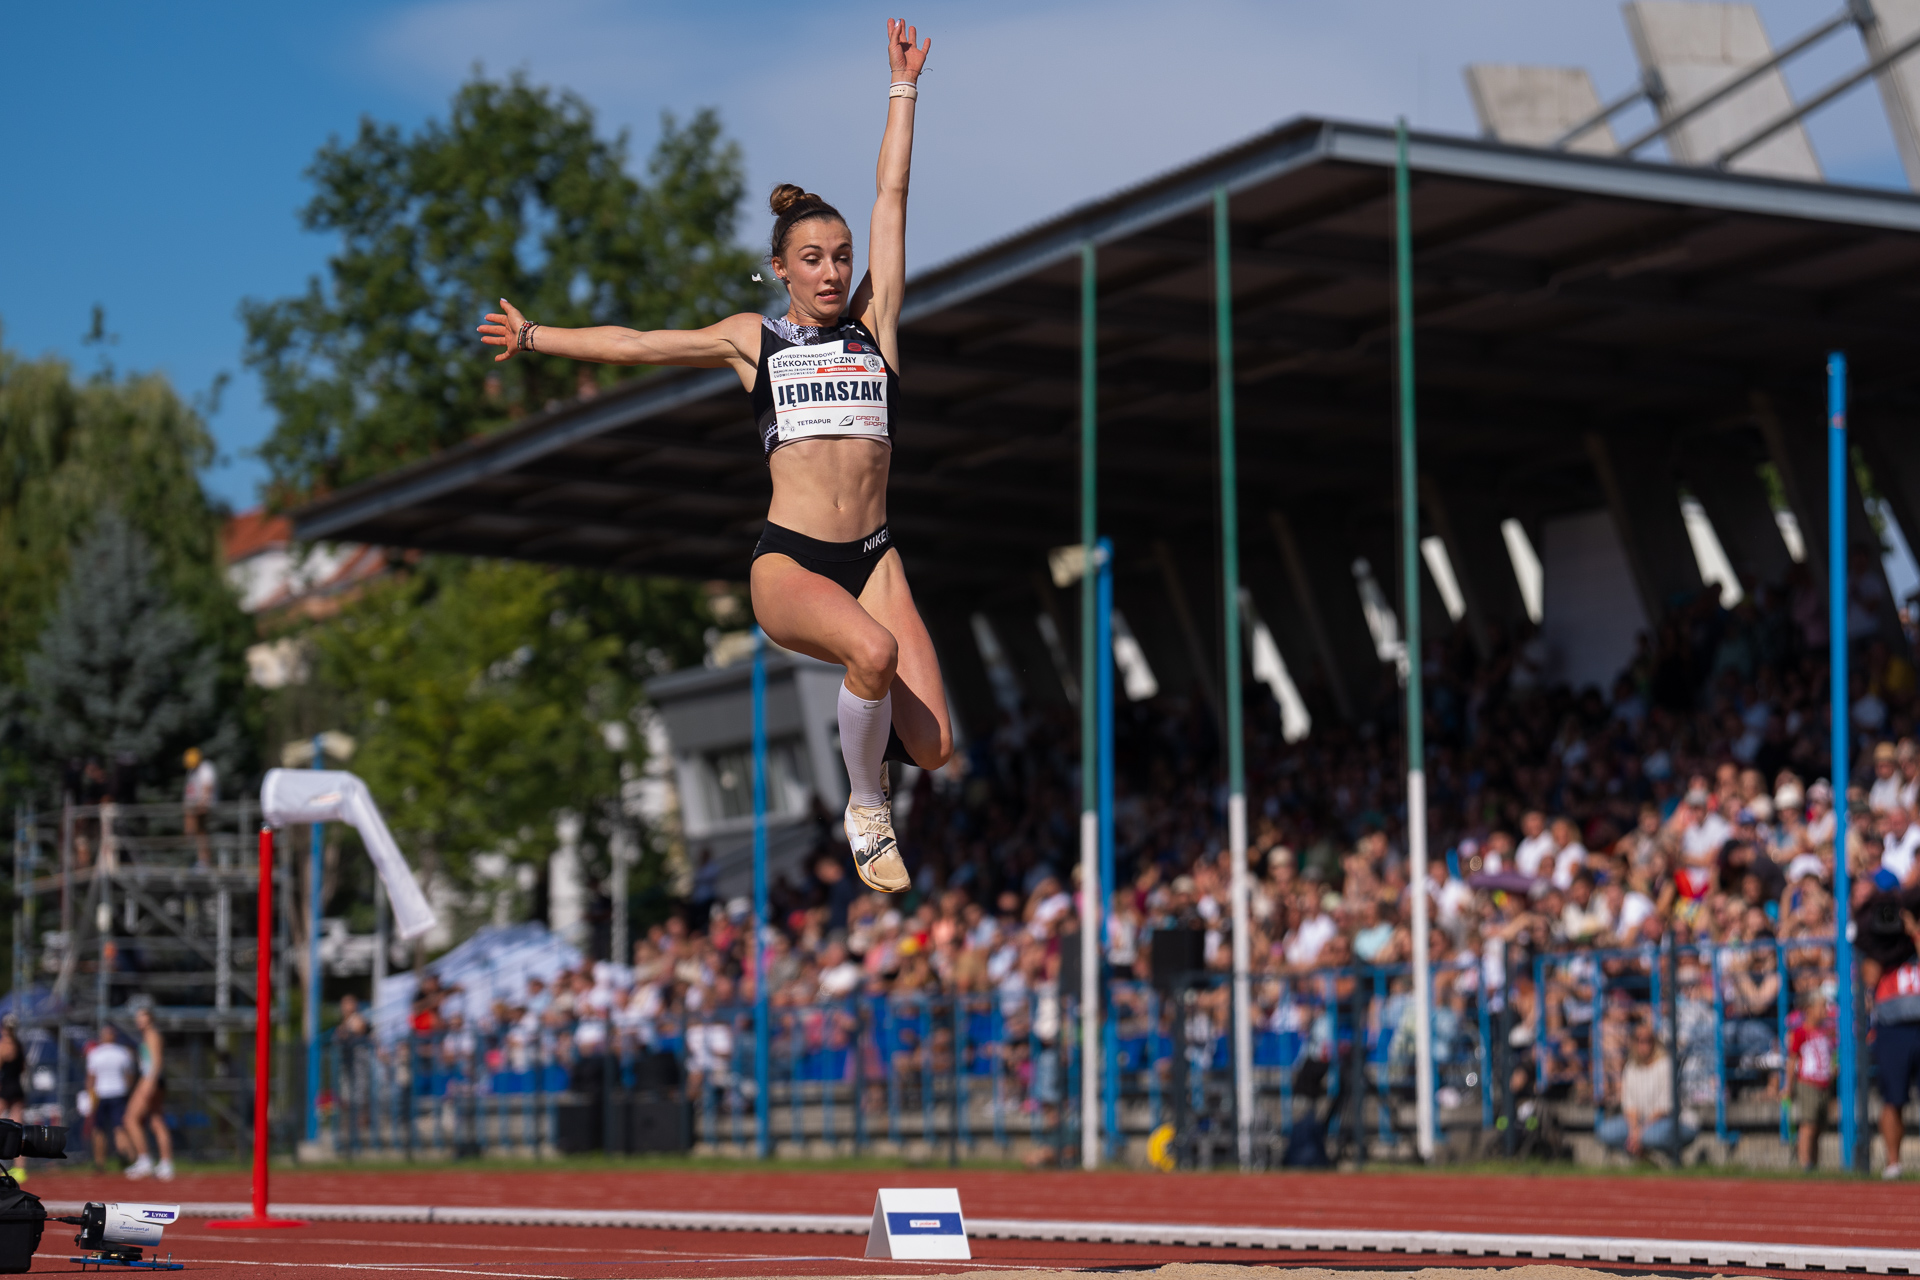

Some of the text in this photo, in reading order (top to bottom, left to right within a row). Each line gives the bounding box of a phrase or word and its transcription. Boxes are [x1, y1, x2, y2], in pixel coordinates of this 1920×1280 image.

[773, 357, 856, 368] LEKKOATLETYCZNY
[778, 381, 883, 407] JĘDRASZAK
[797, 418, 832, 427] TETRAPUR
[863, 420, 886, 428] SPORT
[863, 529, 887, 553] NIKE
[865, 822, 891, 834] NIKE
